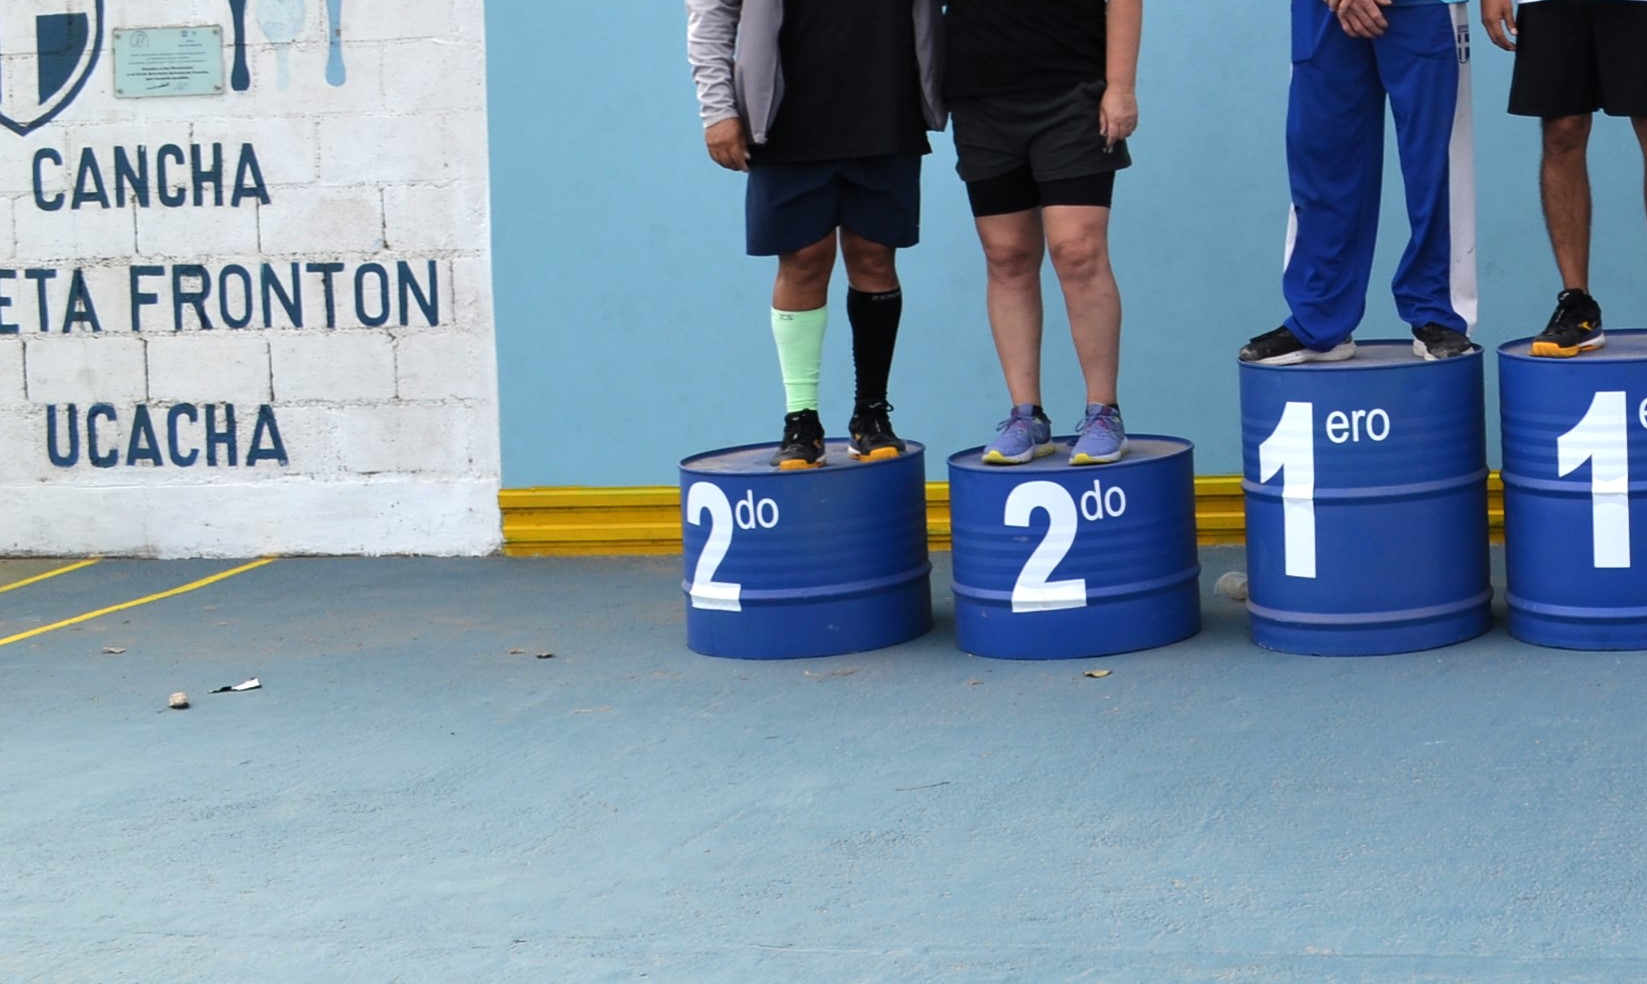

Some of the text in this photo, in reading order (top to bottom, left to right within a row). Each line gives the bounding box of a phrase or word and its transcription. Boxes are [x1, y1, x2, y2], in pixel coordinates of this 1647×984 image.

[32, 142, 271, 212] CANCHA
[130, 260, 439, 334] FRONTON
[46, 402, 289, 469] UCACHA
